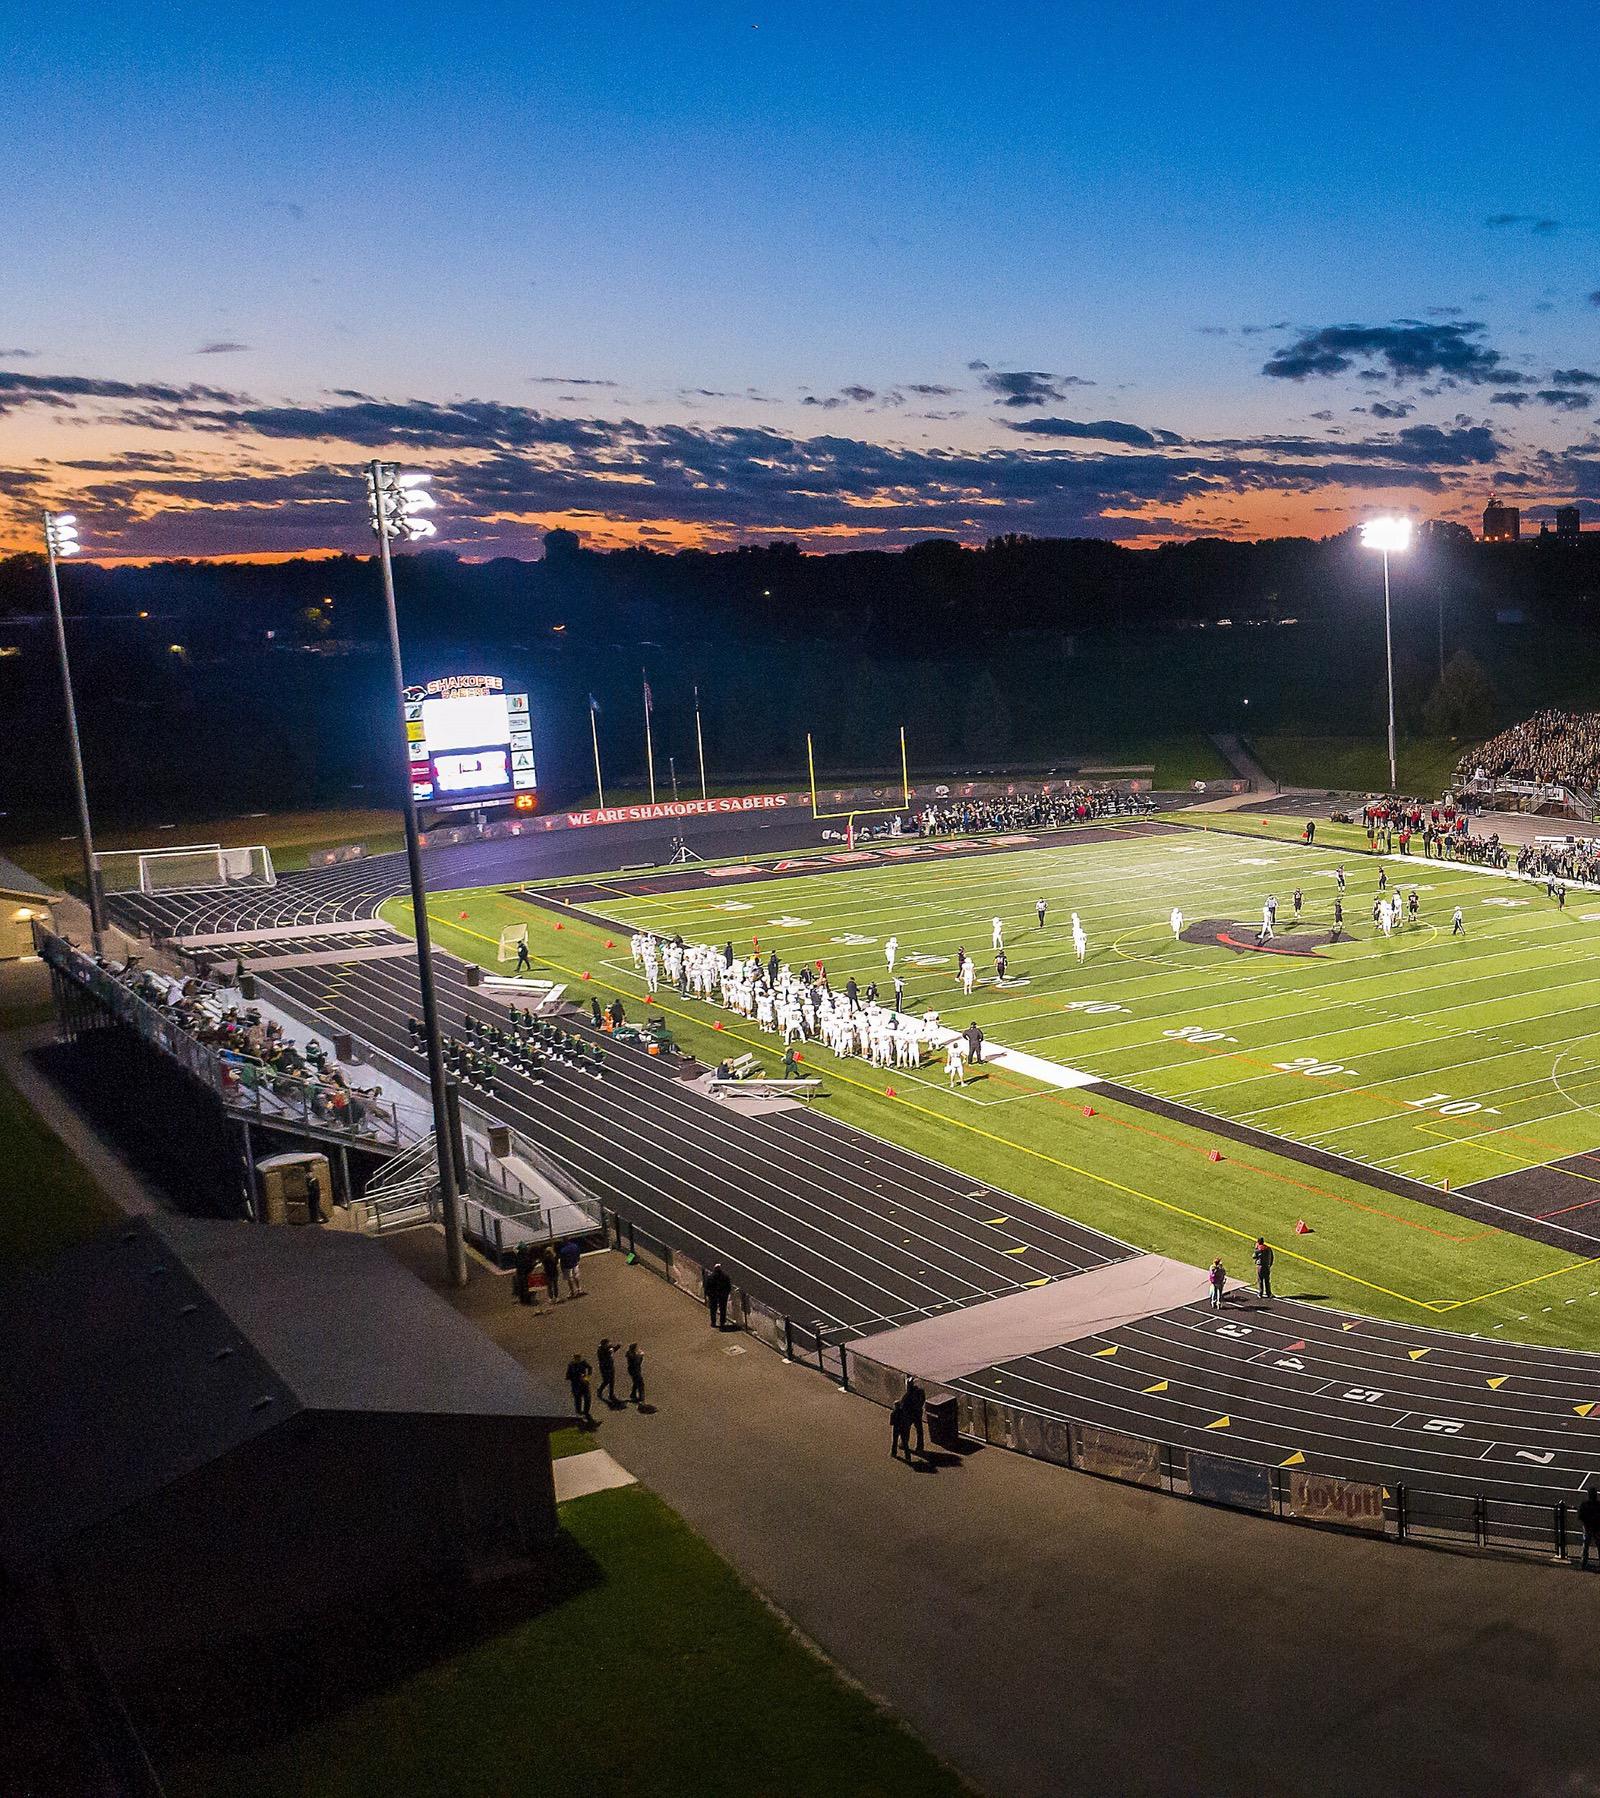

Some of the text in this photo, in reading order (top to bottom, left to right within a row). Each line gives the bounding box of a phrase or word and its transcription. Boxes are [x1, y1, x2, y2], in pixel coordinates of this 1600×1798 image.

[427, 675, 503, 695] SHAKOPEE
[517, 795, 533, 809] 25
[568, 794, 787, 827] WE ARE SHAKOPEE SABERS
[703, 833, 1041, 878] SABERS
[1064, 1001, 1123, 1014] 40
[1162, 1026, 1226, 1044] 30
[1272, 1057, 1347, 1077] 20
[1403, 1092, 1483, 1116] 10
[1216, 1324, 1253, 1338] 3
[1273, 1356, 1306, 1371] 4
[1342, 1387, 1385, 1403] 5
[1422, 1418, 1465, 1434] 6
[1515, 1450, 1556, 1464] 7
